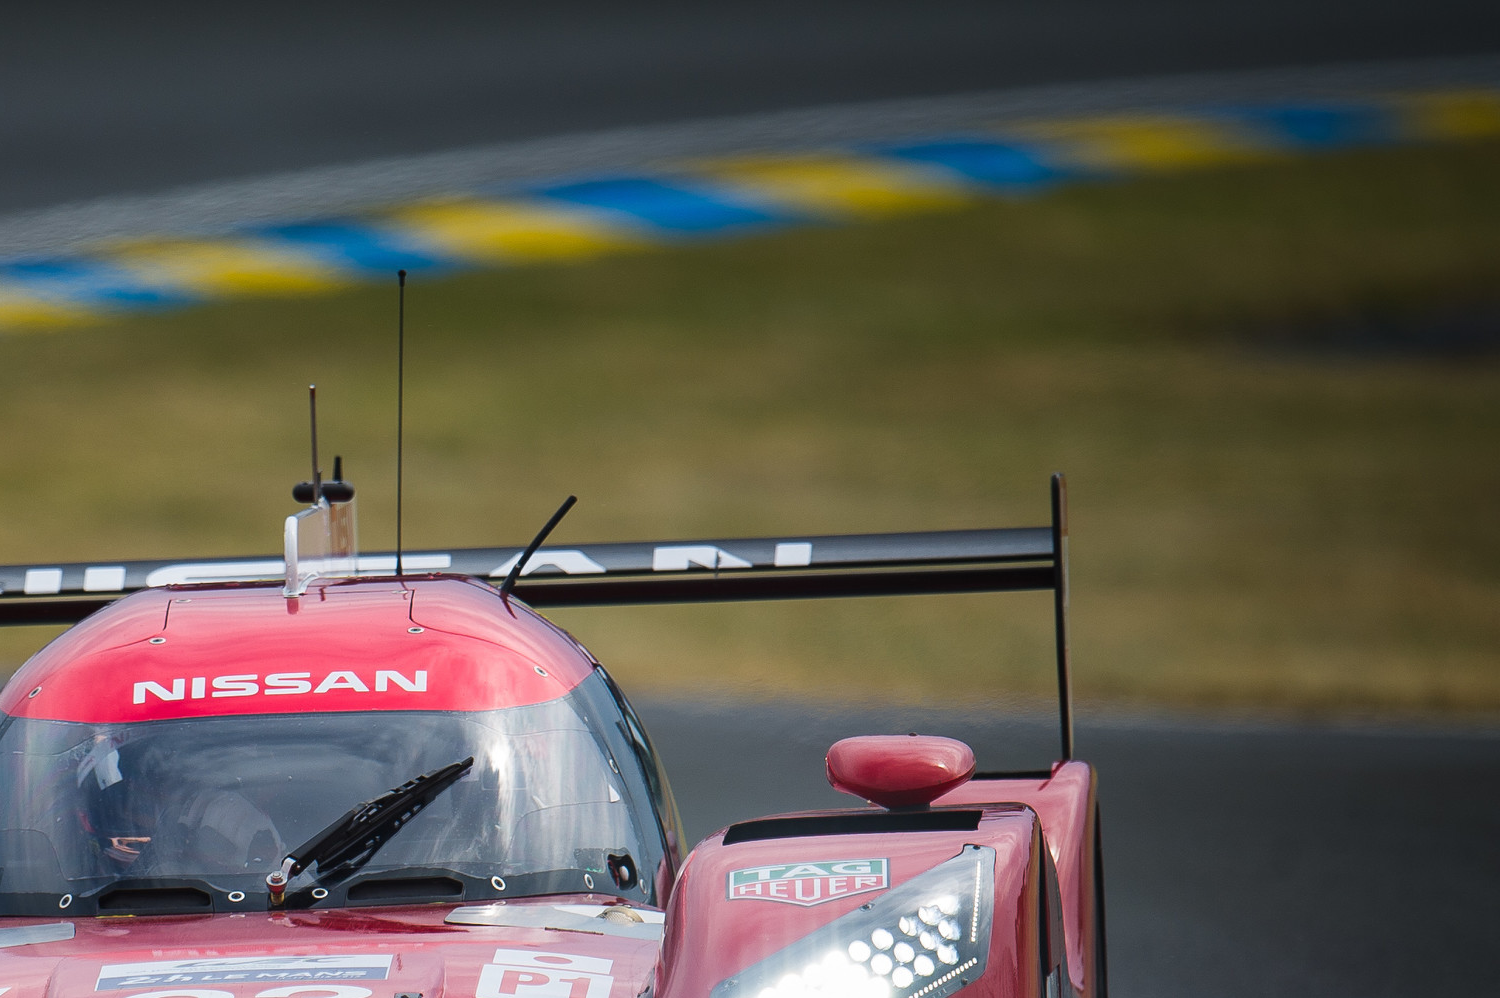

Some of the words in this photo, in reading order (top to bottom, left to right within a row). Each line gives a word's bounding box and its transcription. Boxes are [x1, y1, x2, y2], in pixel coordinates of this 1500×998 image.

[132, 669, 428, 705] NISSAN
[743, 862, 871, 881] TAG
[739, 876, 877, 901] HEUER
